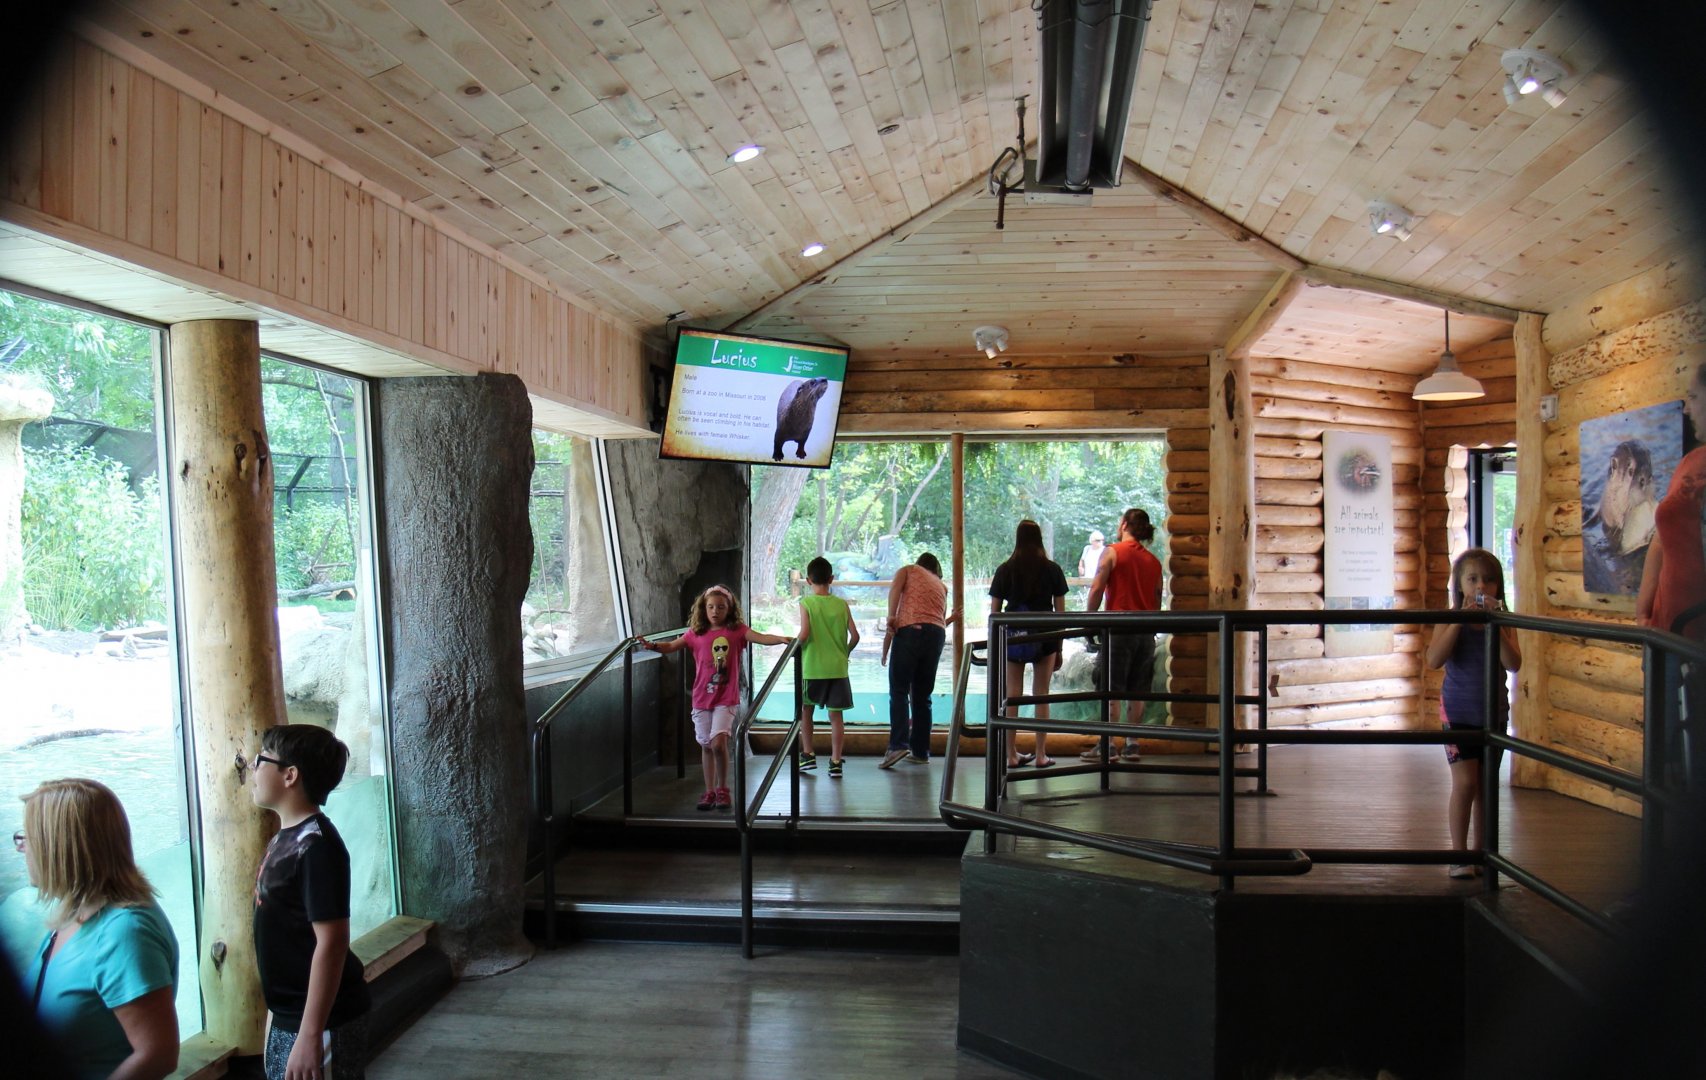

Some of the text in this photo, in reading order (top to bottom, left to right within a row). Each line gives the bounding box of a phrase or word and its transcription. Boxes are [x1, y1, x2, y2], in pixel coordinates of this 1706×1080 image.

[710, 339, 758, 368] Lucius
[725, 392, 747, 400] Missouri
[677, 415, 691, 423] often
[714, 419, 736, 427] climbing
[1340, 504, 1379, 520] All animals
[1334, 521, 1385, 536] are important!
